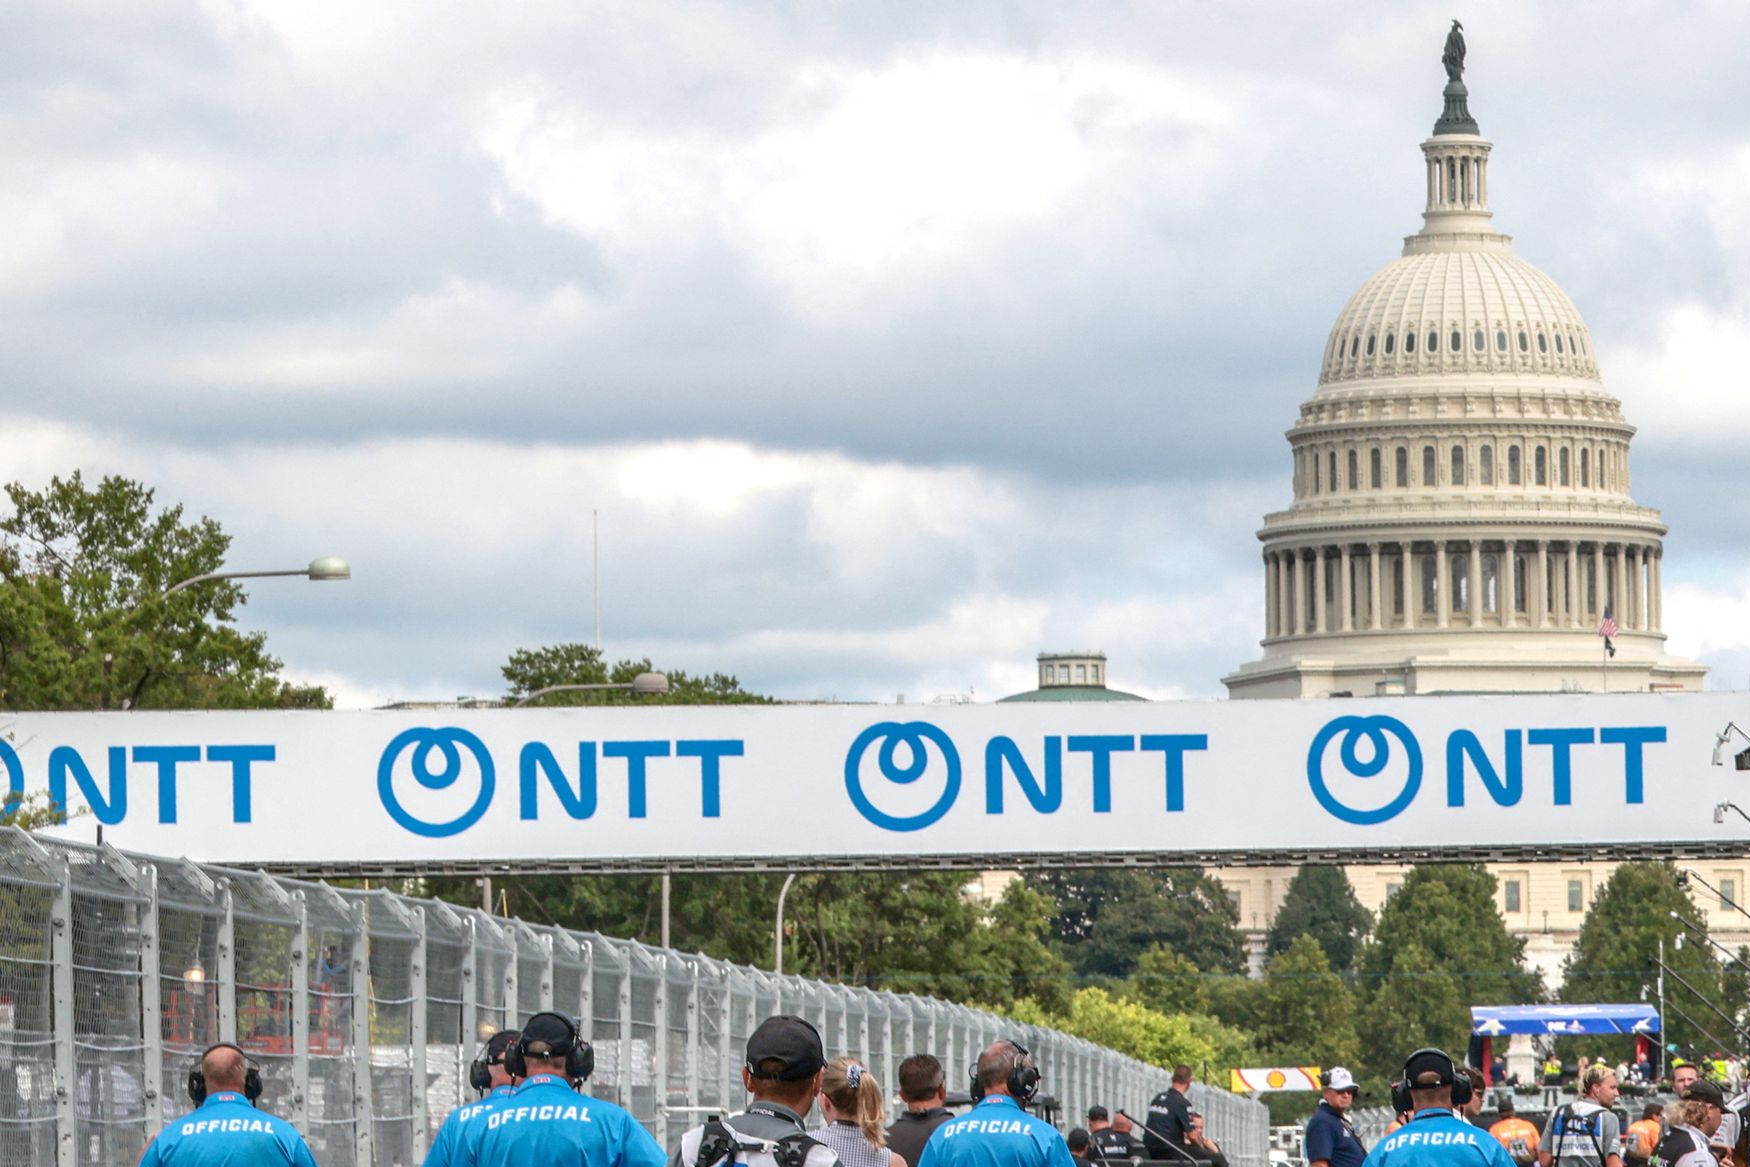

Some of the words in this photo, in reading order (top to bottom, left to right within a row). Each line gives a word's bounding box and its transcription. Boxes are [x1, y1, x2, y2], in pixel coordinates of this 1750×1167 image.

[48, 744, 277, 826] NTT
[519, 738, 745, 821] NTT
[985, 733, 1208, 815] NTT
[1446, 725, 1668, 808] NTT
[182, 1118, 275, 1136] OFFICIAL
[488, 1105, 592, 1130] OFFICIAL
[944, 1119, 1033, 1139] OFFICIAL
[1384, 1131, 1478, 1152] OFFICIAL
